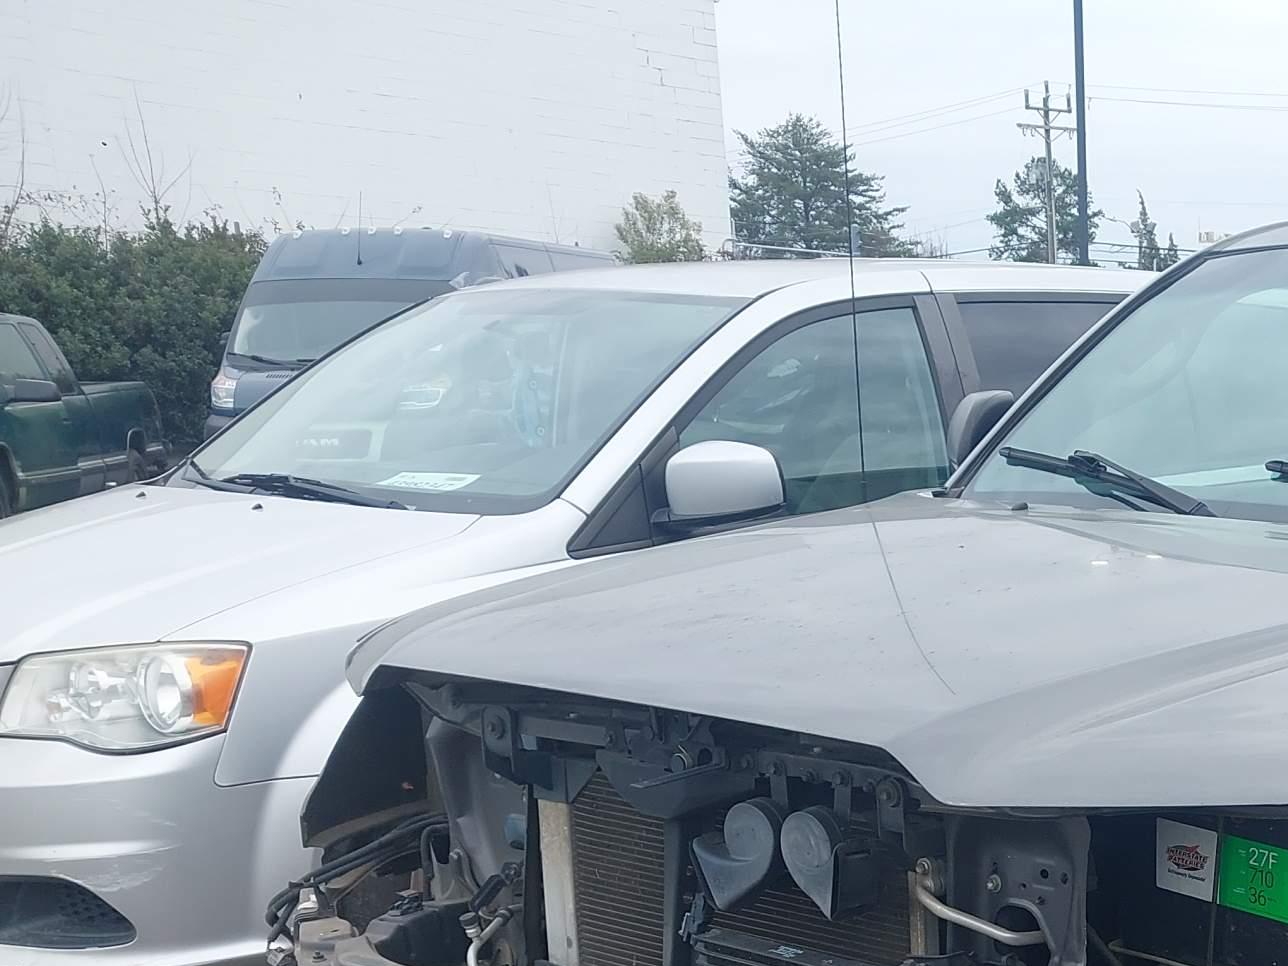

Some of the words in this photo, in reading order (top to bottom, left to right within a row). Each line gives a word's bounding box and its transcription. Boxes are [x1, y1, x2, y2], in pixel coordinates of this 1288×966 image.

[1249, 848, 1279, 869] 27F
[1249, 867, 1274, 889] 710
[1248, 887, 1267, 906] 36
